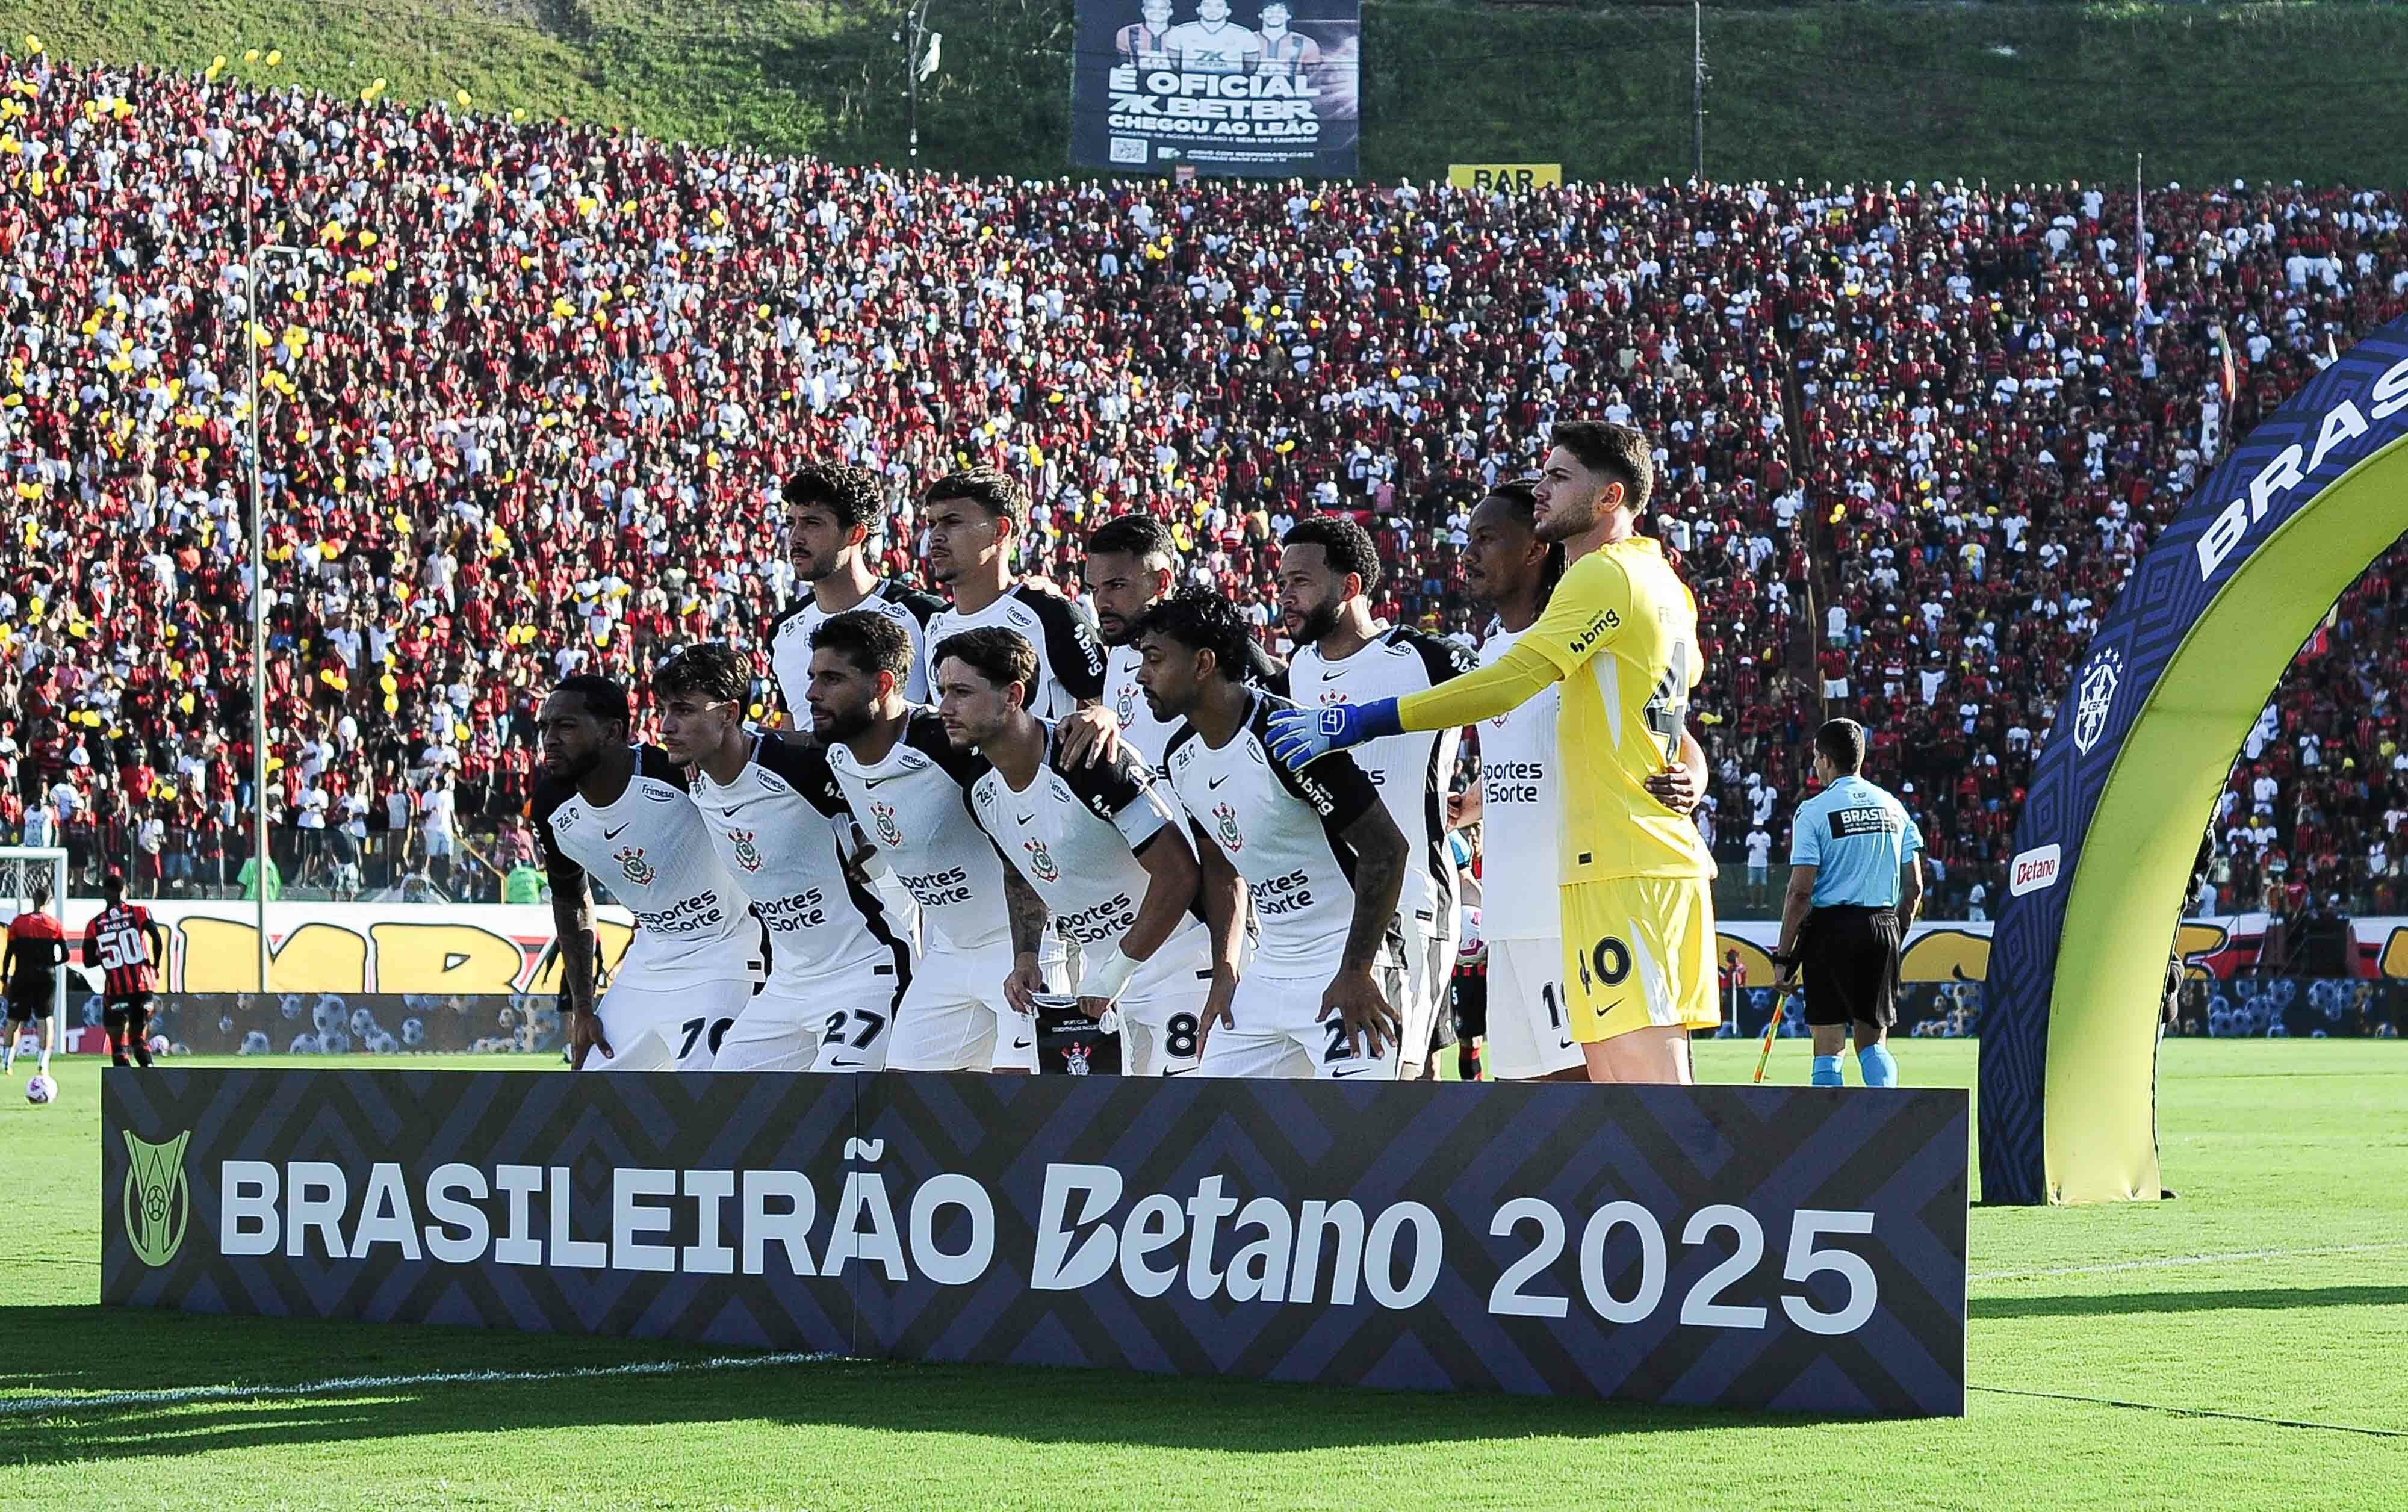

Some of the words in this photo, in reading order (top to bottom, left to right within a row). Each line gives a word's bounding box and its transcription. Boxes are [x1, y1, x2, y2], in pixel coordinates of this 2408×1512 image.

[1109, 63, 1137, 91] É
[1147, 72, 1320, 98] OFICIAL
[1108, 114, 1210, 133] CHEGOU
[1213, 121, 1250, 135] AO
[1254, 120, 1320, 135] LEÃO
[1474, 169, 1533, 196] BAR
[1579, 608, 1621, 645] bmg
[1077, 637, 1104, 677] bmg
[642, 784, 675, 799] Frimesa
[1300, 776, 1335, 816] bmg
[1840, 808, 1890, 824] BRASIL
[898, 866, 967, 890] portes
[1250, 869, 1309, 898] ortes
[2016, 858, 2056, 886] Betano
[753, 887, 823, 915] portes
[1058, 892, 1132, 928] portes
[96, 928, 144, 969] 50
[1542, 980, 1570, 1029] 1
[823, 1008, 886, 1050] 27
[1165, 1011, 1200, 1059] 8
[220, 1136, 995, 1285] BRASILEIRÃO
[1030, 1163, 1443, 1309] Betano
[1488, 1197, 1878, 1335] 2025
